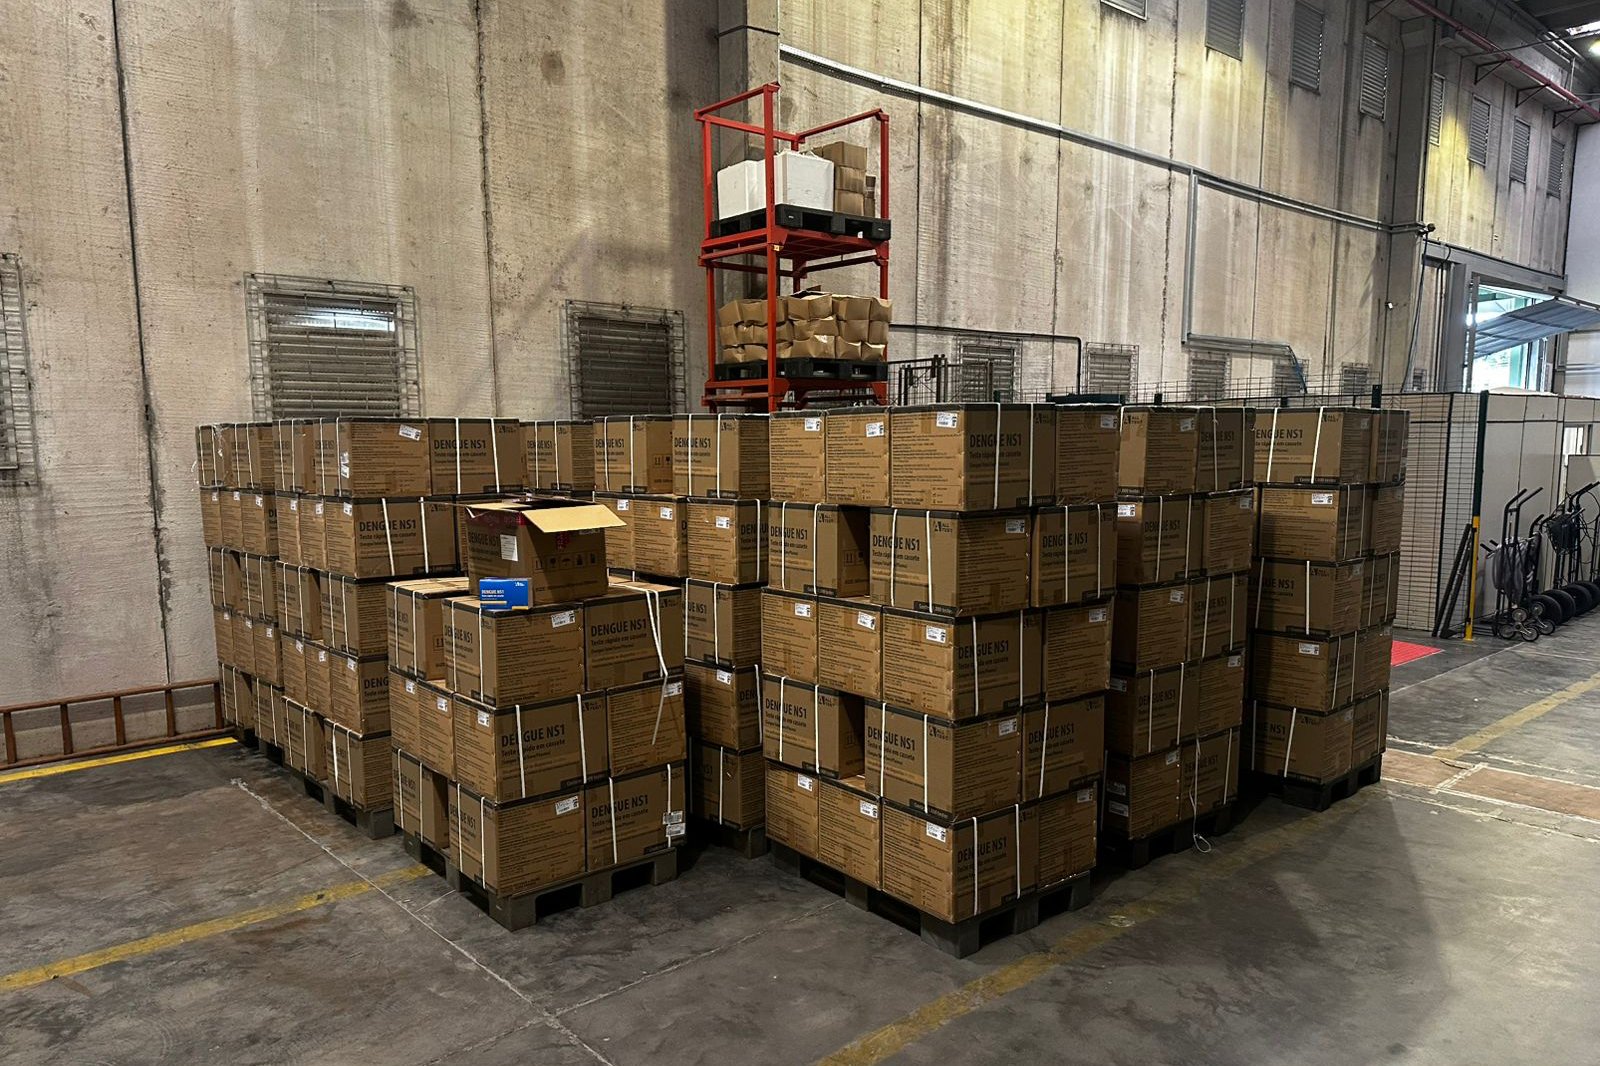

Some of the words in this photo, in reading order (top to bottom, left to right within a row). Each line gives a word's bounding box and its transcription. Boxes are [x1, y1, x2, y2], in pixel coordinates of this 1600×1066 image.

[969, 433, 1005, 448] DENUE
[1006, 433, 1022, 446] NS1
[1256, 429, 1285, 439] ENGUE
[1286, 429, 1303, 439] NS1
[471, 439, 486, 449] NS1
[615, 438, 625, 448] NS1
[700, 437, 711, 448] NS1
[400, 519, 416, 530] NS1
[795, 528, 808, 540] NS1
[1042, 533, 1073, 549] DENGE
[1074, 531, 1088, 545] NS1
[905, 537, 920, 552] NS1
[1278, 579, 1294, 590] NS1
[591, 621, 628, 637] DENGUE
[630, 618, 647, 631] NS1
[994, 639, 1009, 653] NS1
[364, 676, 389, 689] DENG
[766, 698, 793, 716] DENUE
[793, 705, 807, 719] NS1
[546, 724, 565, 739] NS1
[1028, 726, 1059, 745] DENUE
[1060, 722, 1074, 737] NS1
[1270, 723, 1286, 735] NS1
[900, 735, 915, 751] NS1
[631, 794, 648, 808] NS1
[449, 803, 467, 824] DENUE
[957, 842, 991, 863] DENUE
[992, 836, 1007, 852] NS1
